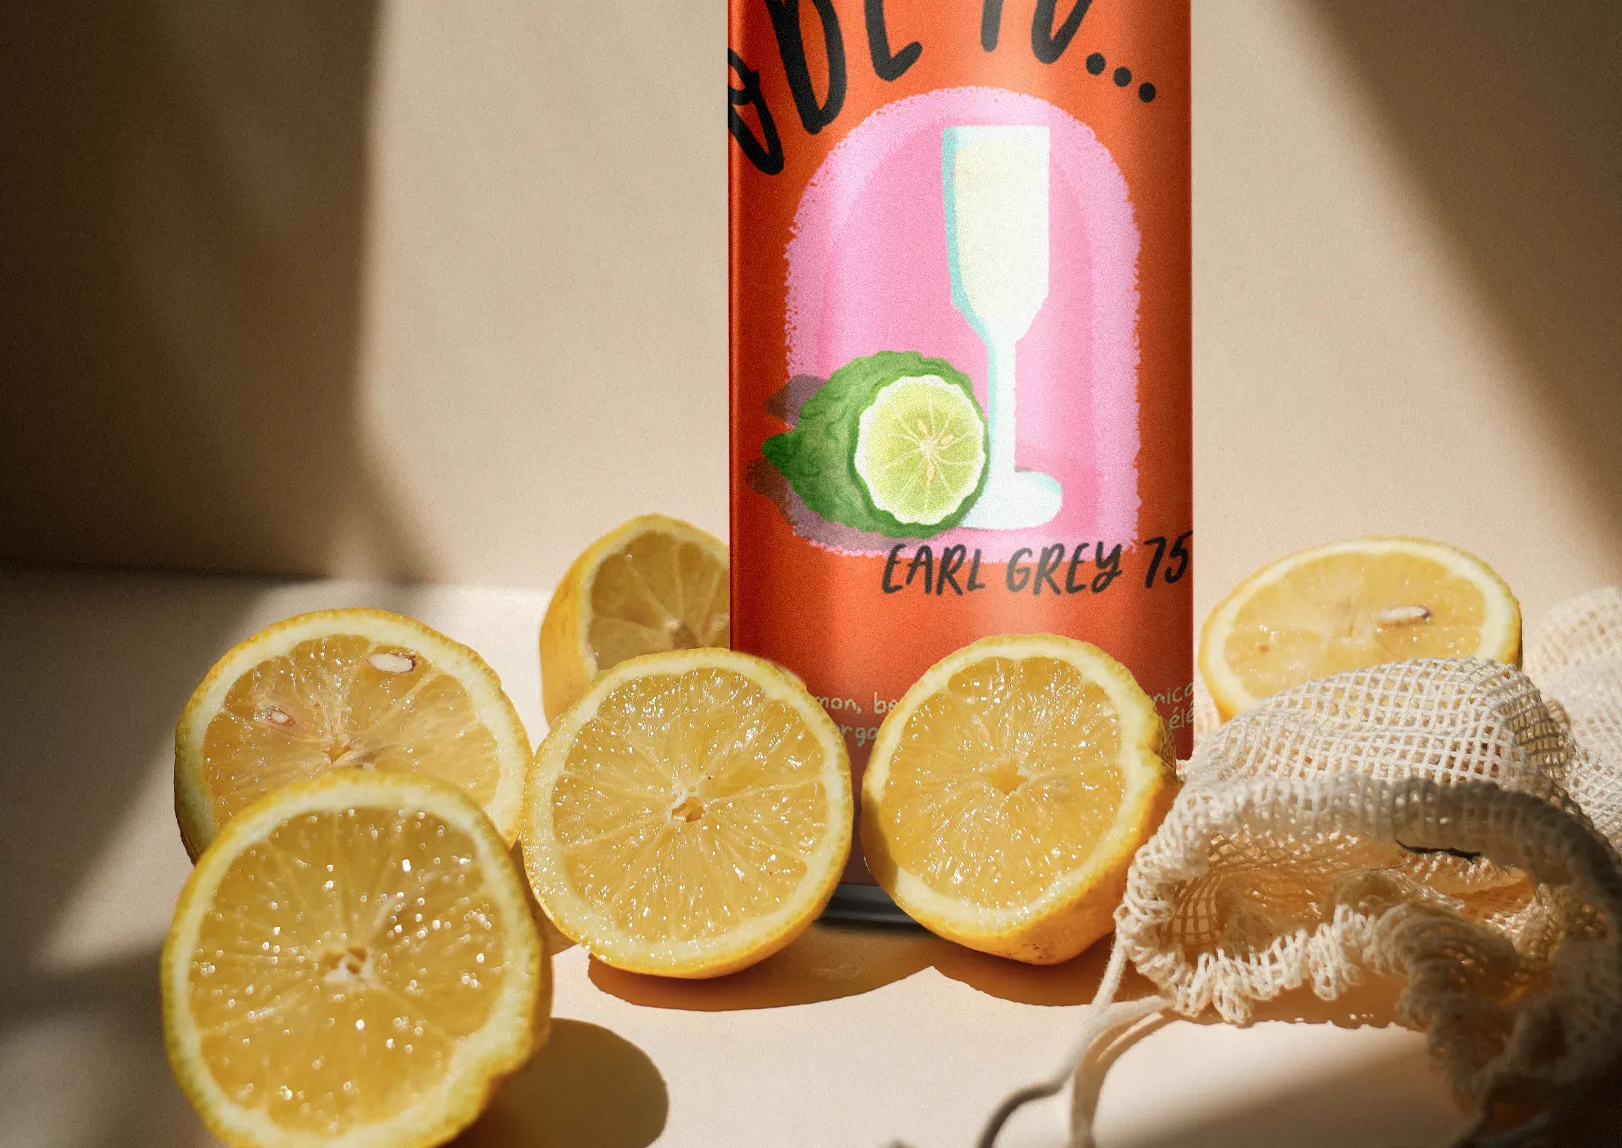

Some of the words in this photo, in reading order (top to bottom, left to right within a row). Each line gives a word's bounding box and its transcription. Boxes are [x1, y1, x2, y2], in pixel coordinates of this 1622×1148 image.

[881, 543, 986, 596] EARL
[1006, 541, 1123, 595] GREY
[1144, 531, 1193, 589] 75
